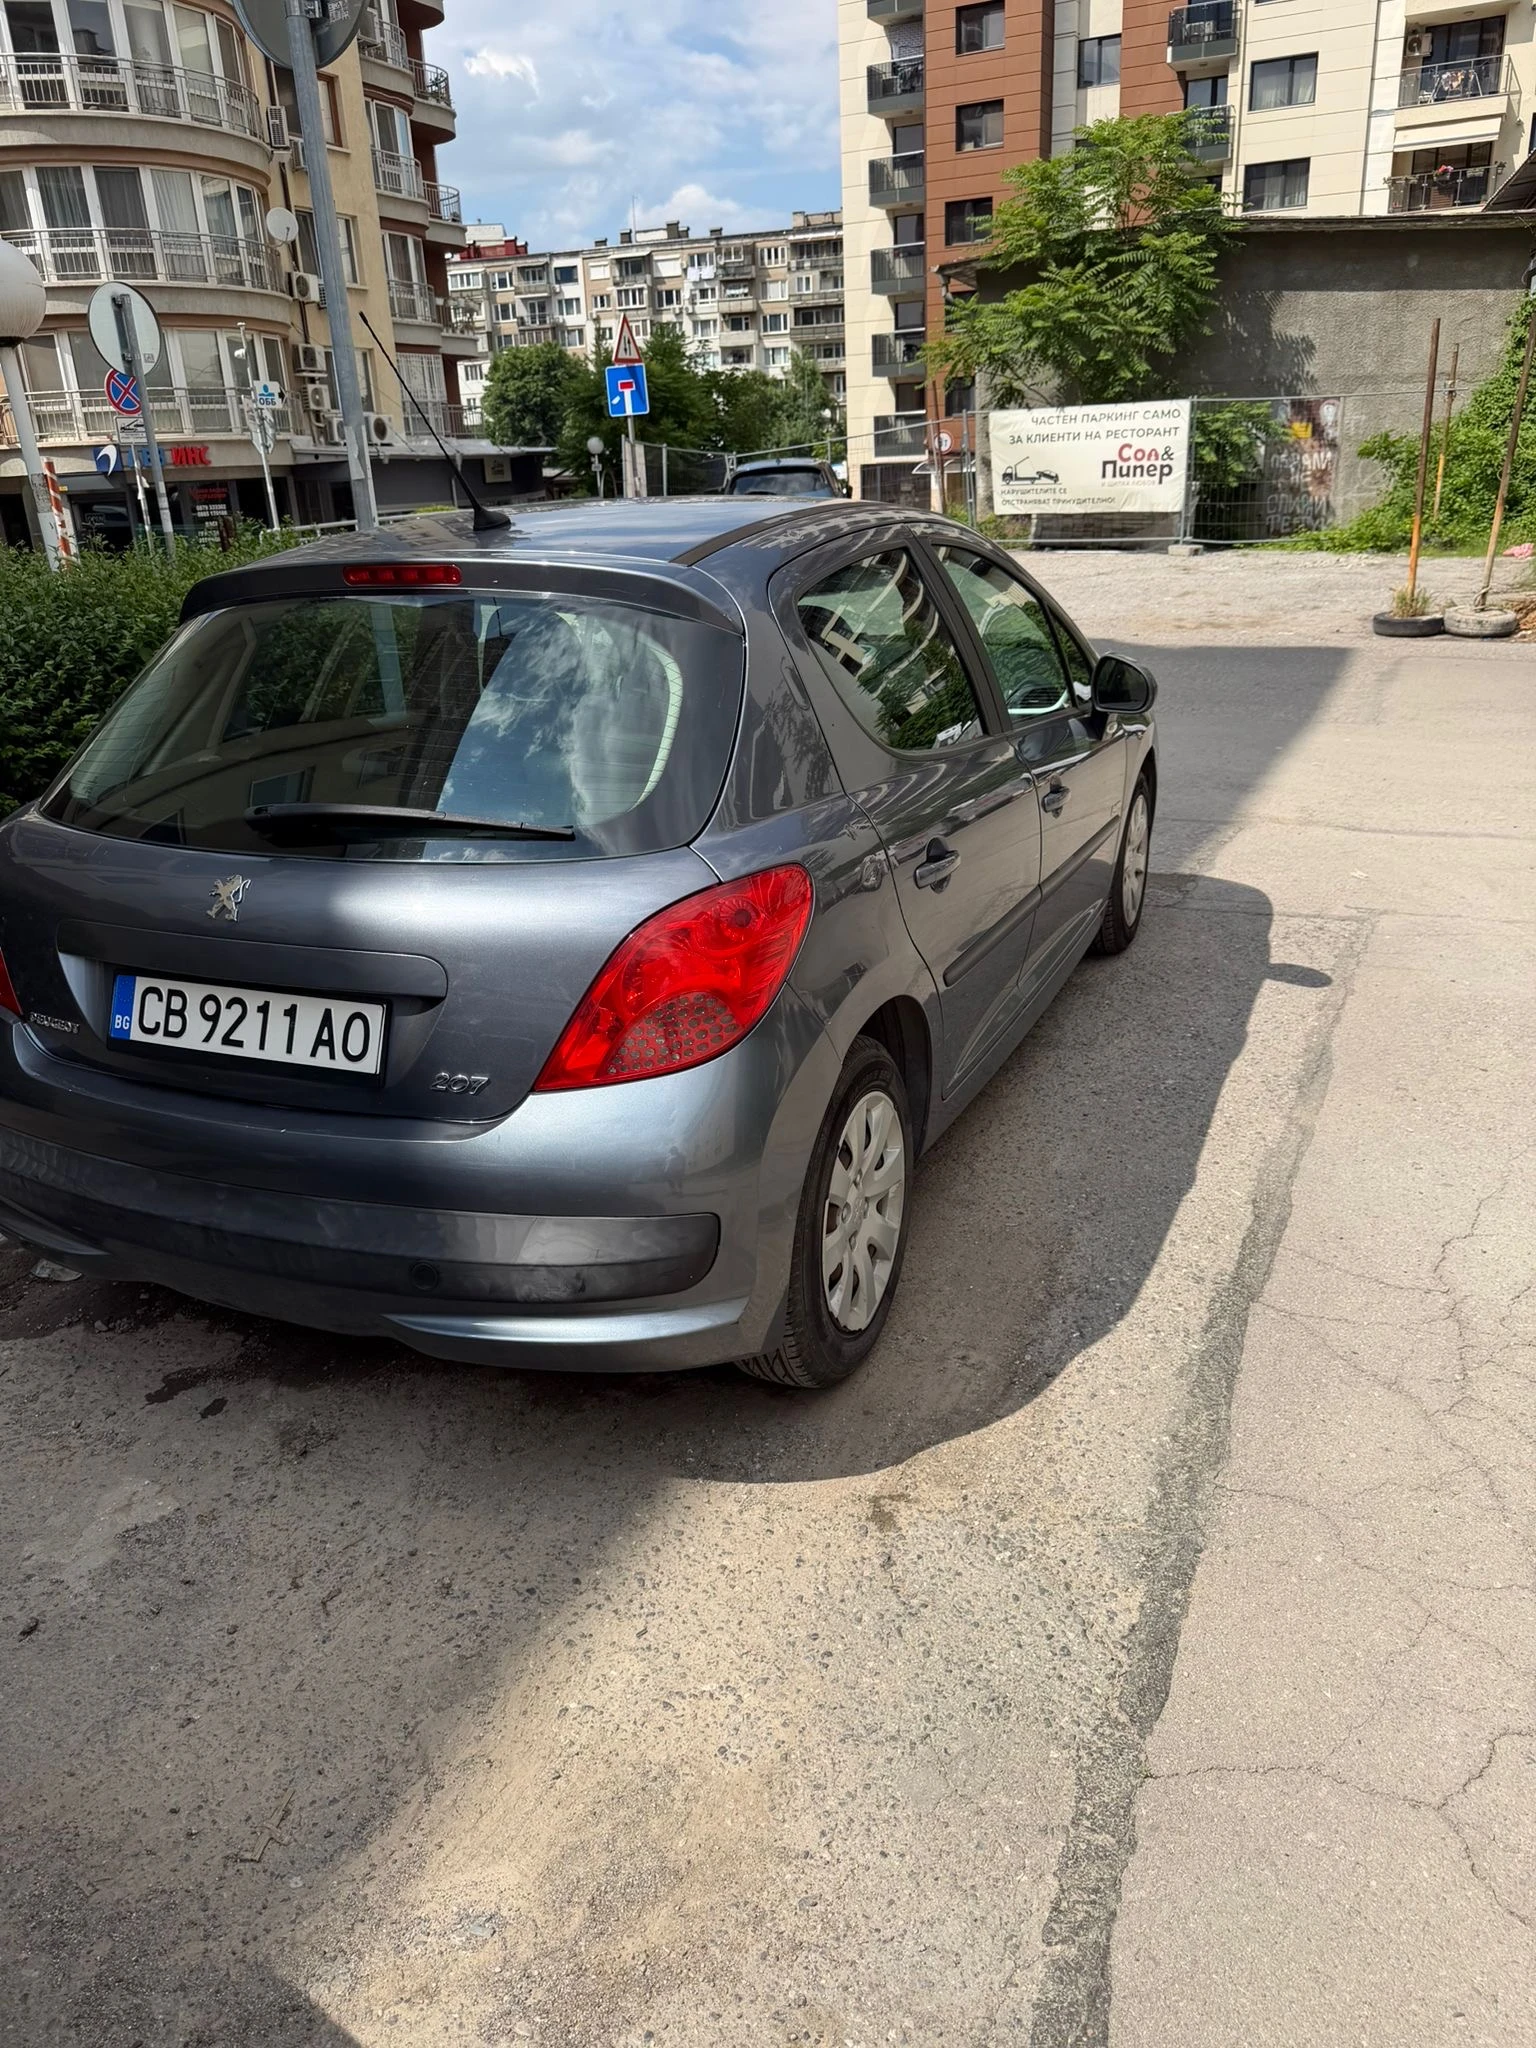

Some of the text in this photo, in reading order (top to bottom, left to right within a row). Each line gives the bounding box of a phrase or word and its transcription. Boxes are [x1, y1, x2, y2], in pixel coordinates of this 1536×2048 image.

[258, 397, 277, 406] ОББ
[1031, 408, 1181, 426] ЧАСТЕН ПАРКИНГ САМО
[1009, 426, 1180, 445] ЗА КЛИЕНТИ НА РЕСТОРАНТ
[171, 445, 211, 465] ИНС
[1101, 459, 1173, 484] Пипер
[114, 1014, 130, 1030] BG
[138, 986, 188, 1038] CB
[201, 993, 299, 1054] 9211
[430, 1071, 490, 1095] 207
